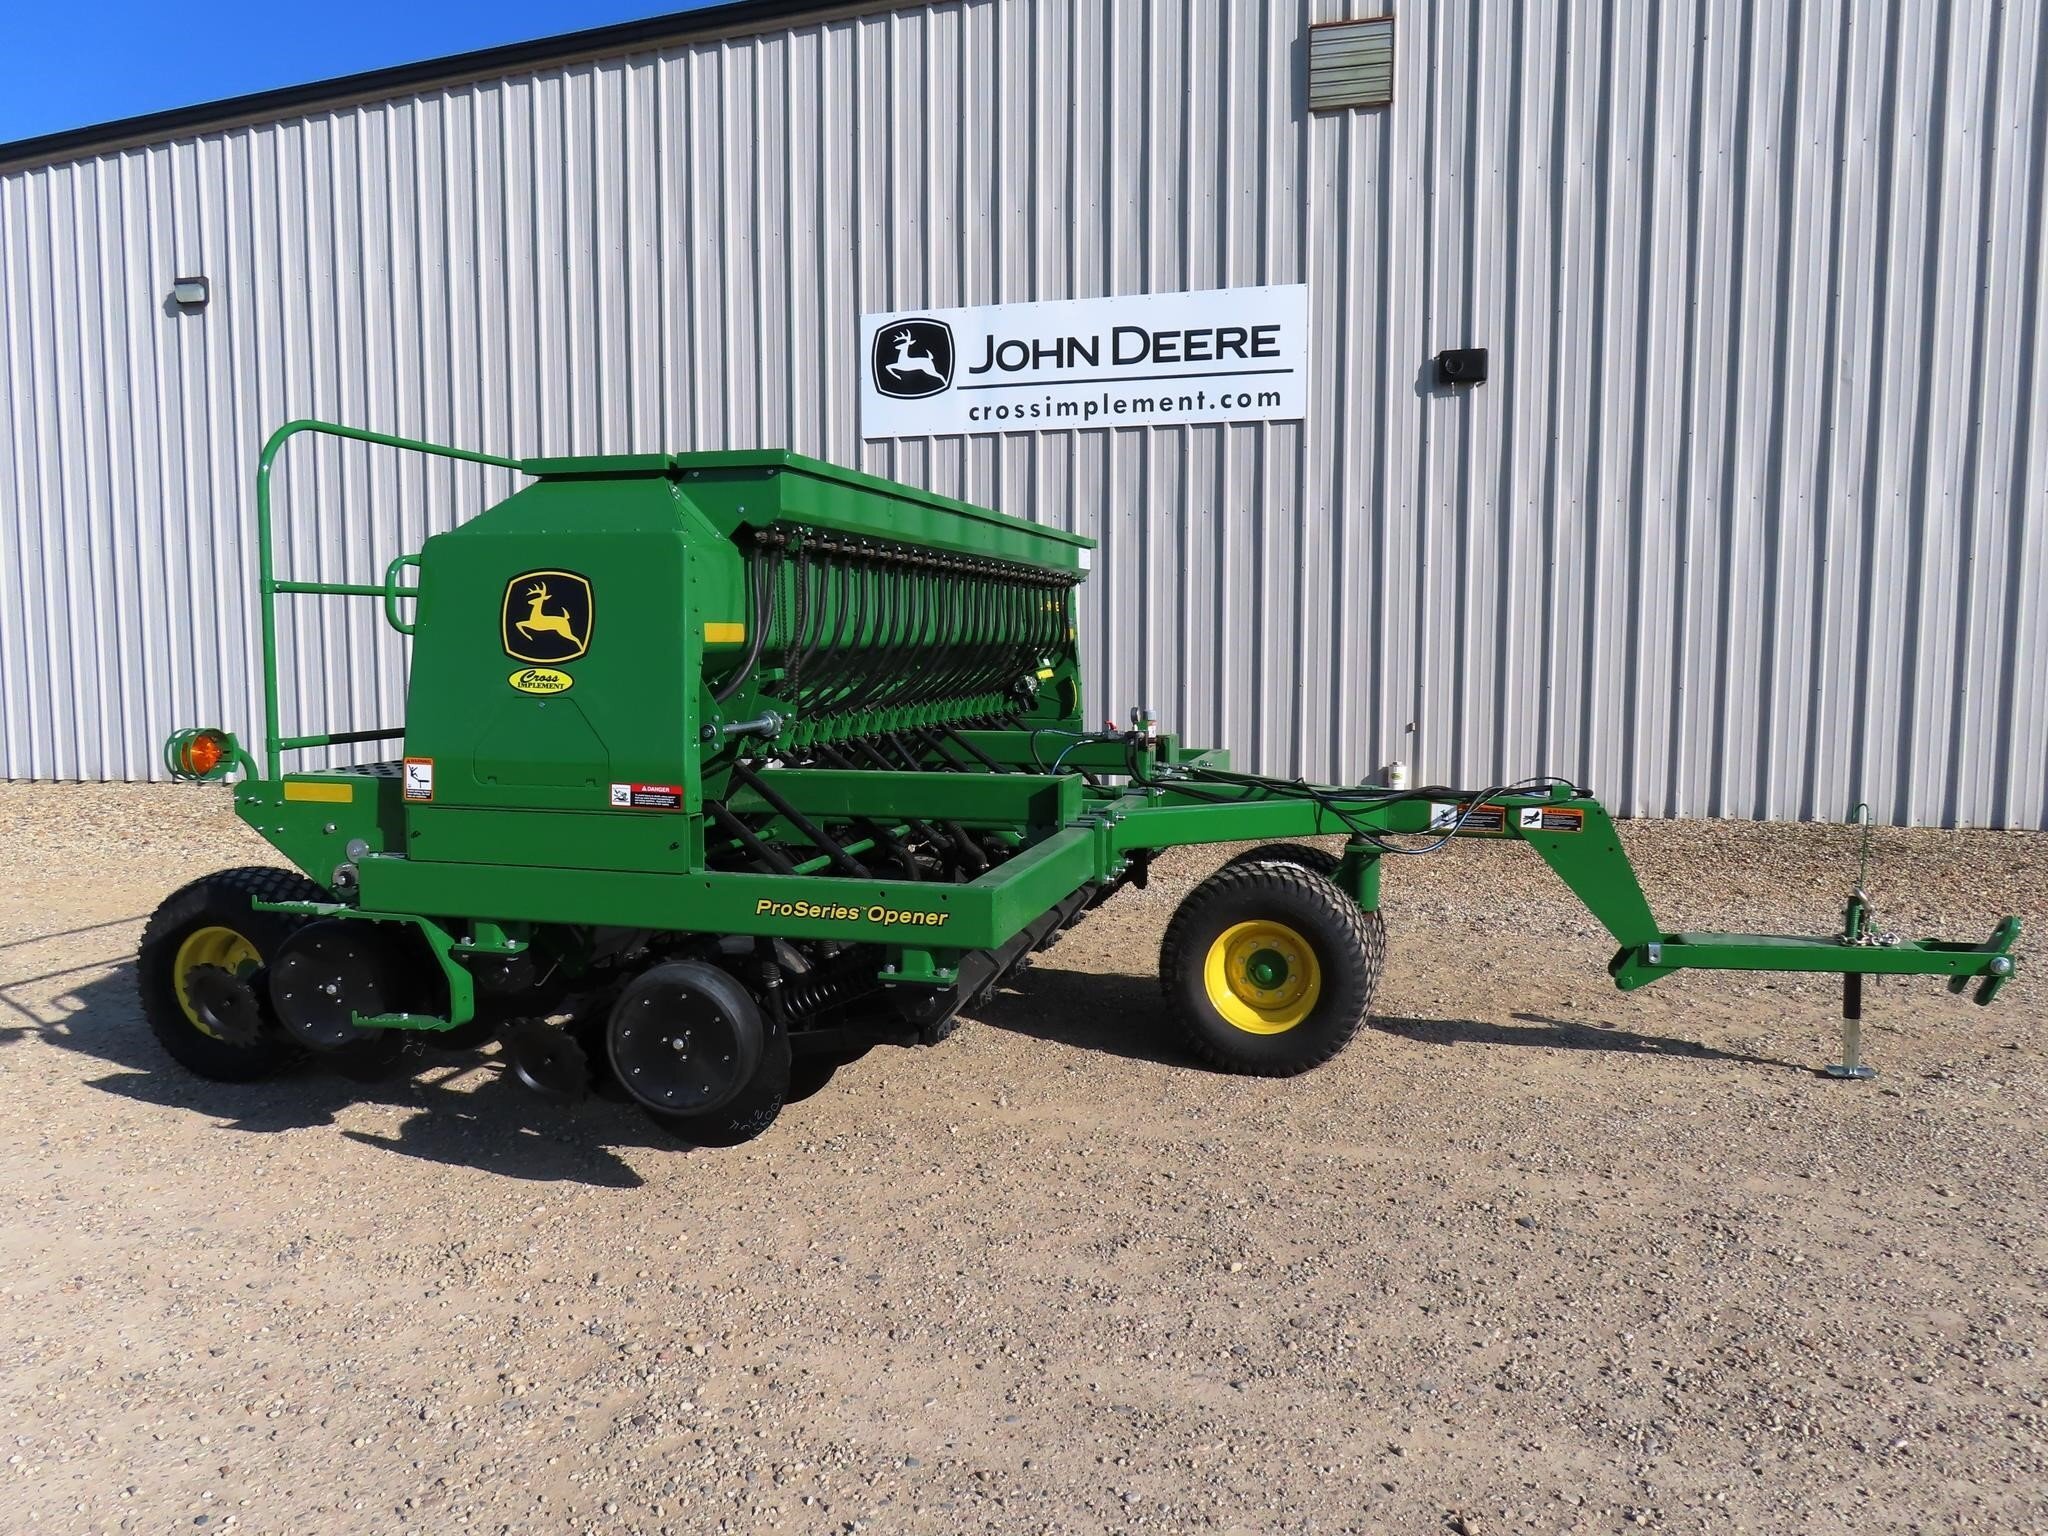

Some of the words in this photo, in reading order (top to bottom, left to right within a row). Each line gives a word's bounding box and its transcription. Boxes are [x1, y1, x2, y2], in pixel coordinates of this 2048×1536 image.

[968, 334, 1099, 375] JOHN
[1112, 324, 1281, 366] DEERE
[969, 390, 1282, 421] crossimplement.com
[517, 682, 564, 690] IMPLEMENT
[520, 670, 559, 683] Cross
[867, 905, 949, 927] Opener
